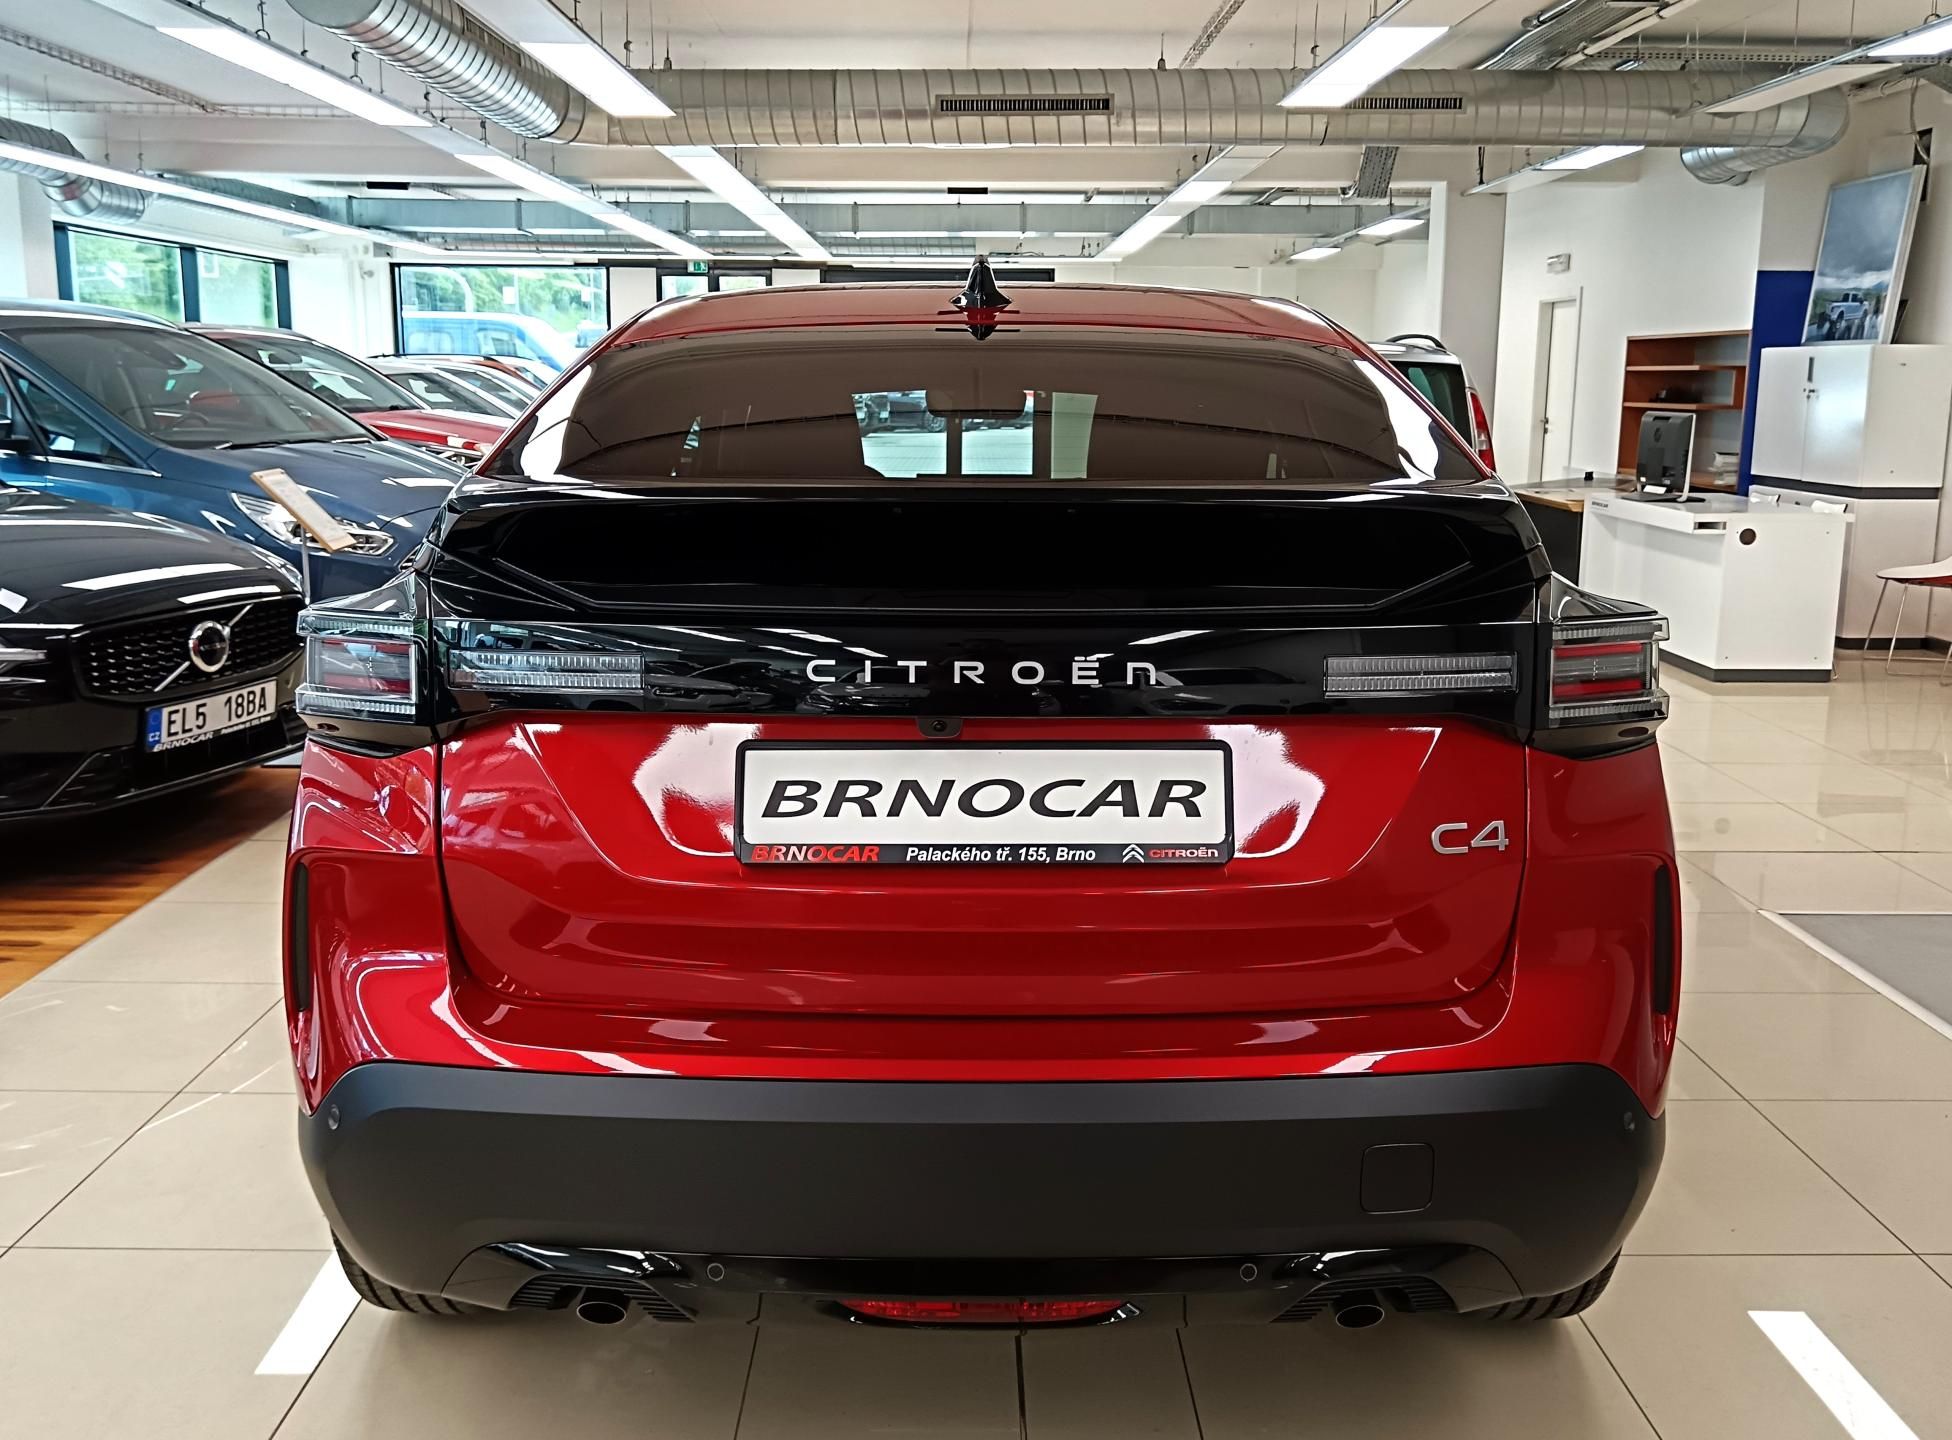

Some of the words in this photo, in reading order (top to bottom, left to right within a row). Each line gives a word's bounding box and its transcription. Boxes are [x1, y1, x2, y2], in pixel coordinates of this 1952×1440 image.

[806, 656, 1157, 685] CITROËN
[166, 703, 207, 737] EL5
[224, 687, 267, 722] 18BA
[149, 731, 161, 742] CZ
[152, 731, 214, 752] BRNOCAR
[761, 779, 1207, 818] BRNOCAR
[1430, 820, 1509, 855] C4
[751, 845, 880, 862] BRNOCAR
[905, 846, 992, 862] Palackého
[995, 846, 1013, 862] tř.
[1018, 847, 1051, 864] 155,
[1055, 846, 1096, 862] Brno
[1148, 846, 1219, 858] CITROËN
